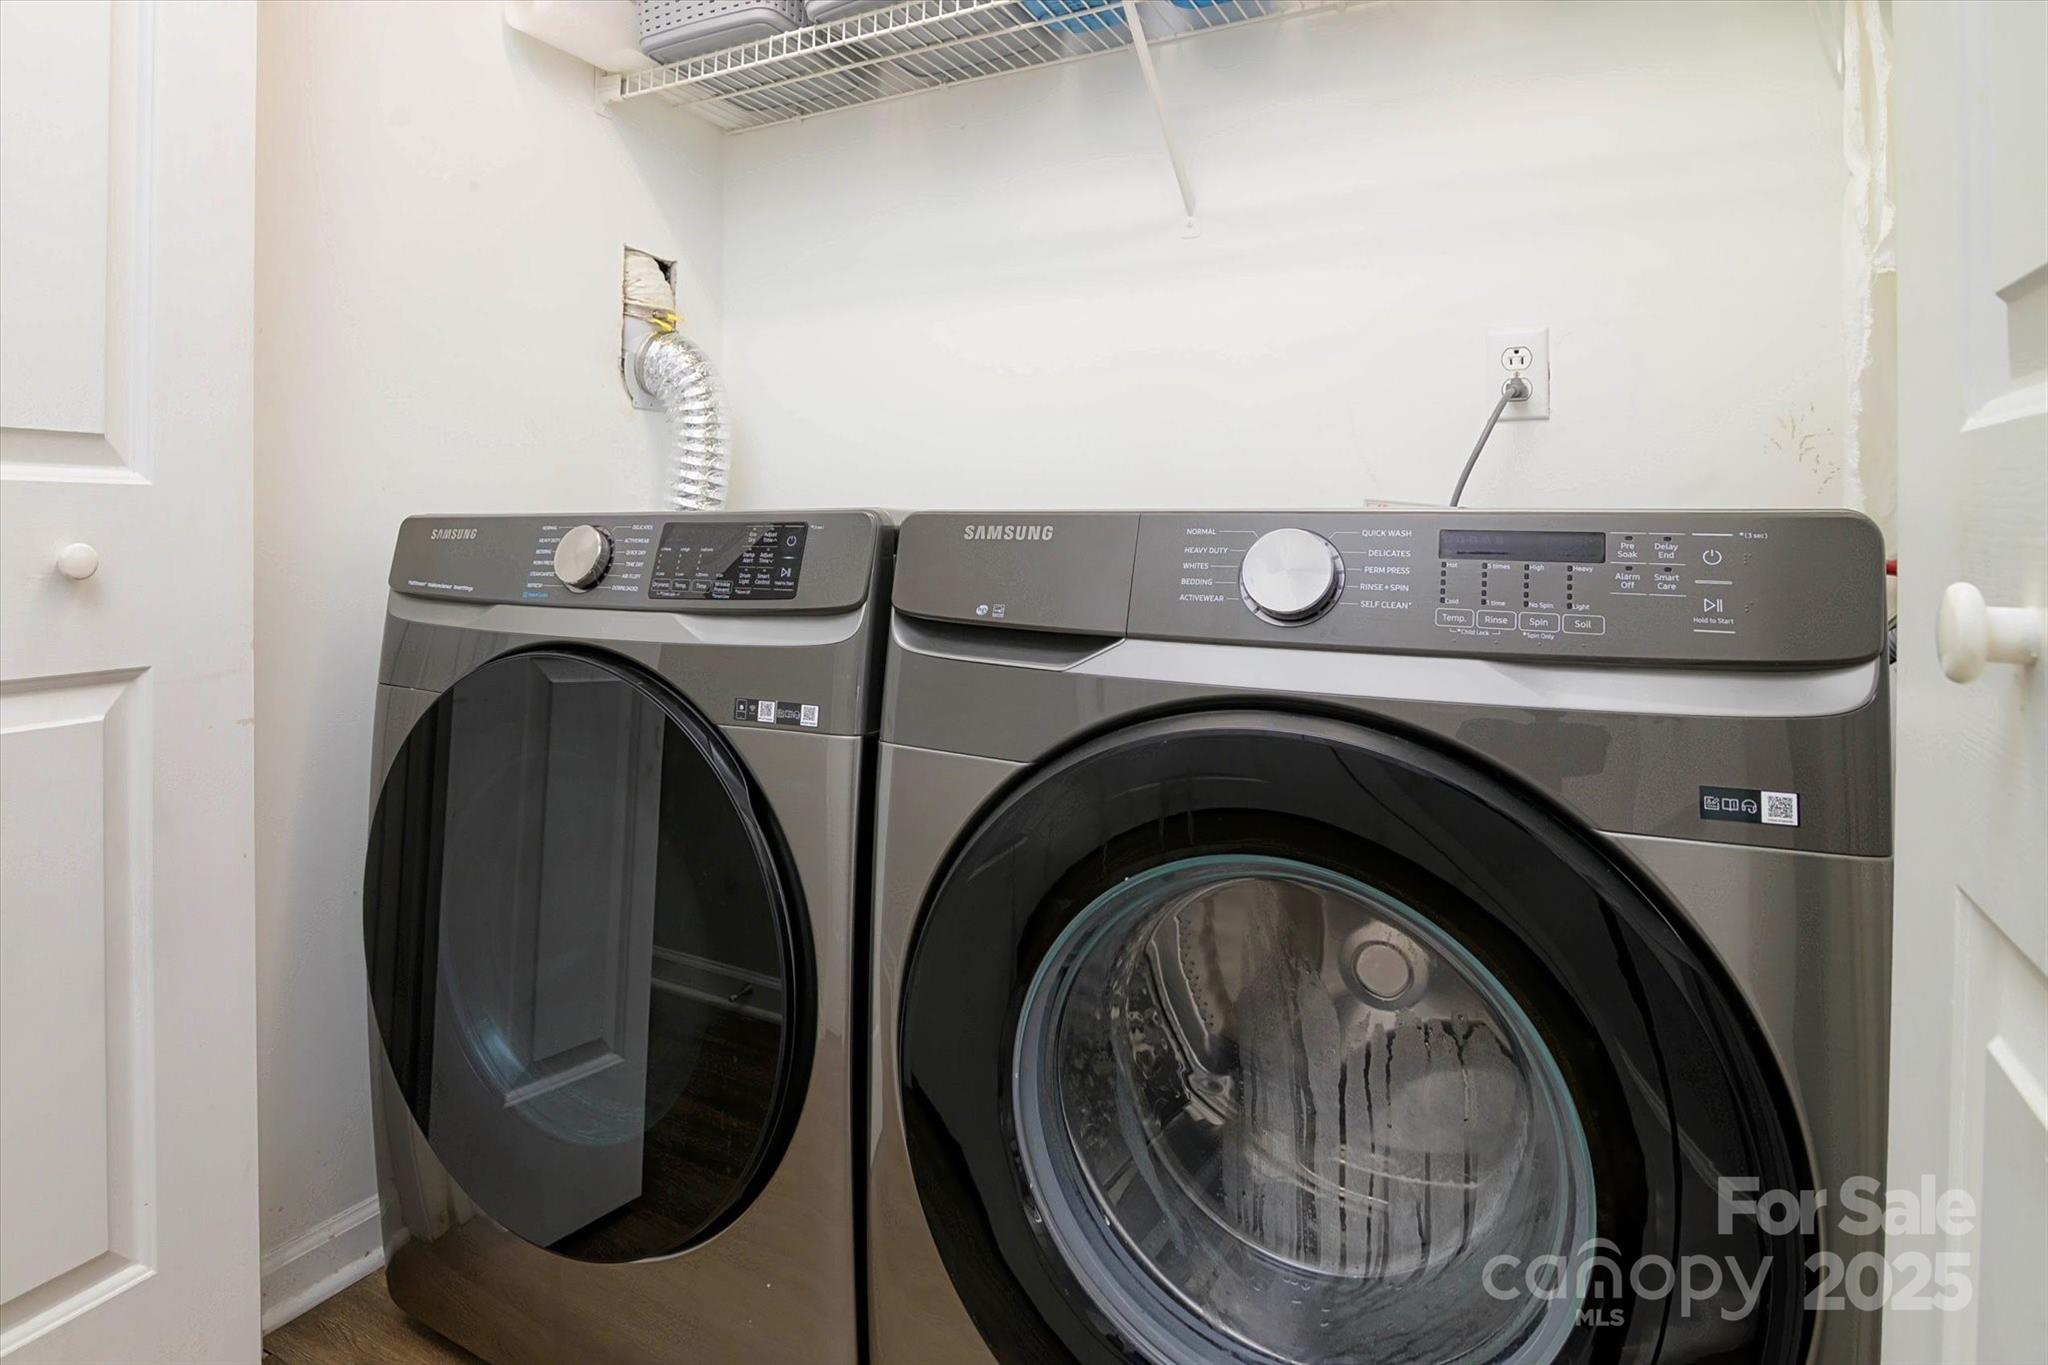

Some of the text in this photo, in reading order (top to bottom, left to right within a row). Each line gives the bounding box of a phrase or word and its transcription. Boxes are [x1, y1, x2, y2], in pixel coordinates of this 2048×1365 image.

[430, 528, 478, 540] SAMSUNG
[963, 525, 1054, 541] SAMSUNG
[1361, 529, 1412, 537] QUICK WASH
[1620, 542, 1635, 550] Pre
[1654, 542, 1679, 552] Delay
[1368, 549, 1411, 558] DELICATES
[1617, 550, 1638, 558] Soak
[1364, 566, 1410, 575] PERM PRESS
[1529, 564, 1545, 572] High
[1573, 565, 1593, 573] Heavy
[1615, 573, 1641, 581] Alarm
[1654, 573, 1679, 582] Smart
[1360, 583, 1384, 591] RINSE
[1390, 584, 1409, 592] SPIN
[1620, 581, 1636, 589] Off
[1657, 582, 1677, 590] Care
[1179, 594, 1224, 602] ACTIVEWEAR
[1360, 600, 1380, 608] SELF
[1540, 602, 1554, 610] Spin
[1572, 603, 1590, 611] Light
[1442, 613, 1467, 624] Temp.
[1484, 615, 1508, 625] Rinse
[1529, 617, 1549, 628] Spin
[1717, 617, 1734, 625] Start
[1574, 619, 1592, 629] Soil
[1540, 633, 1555, 641] Only
